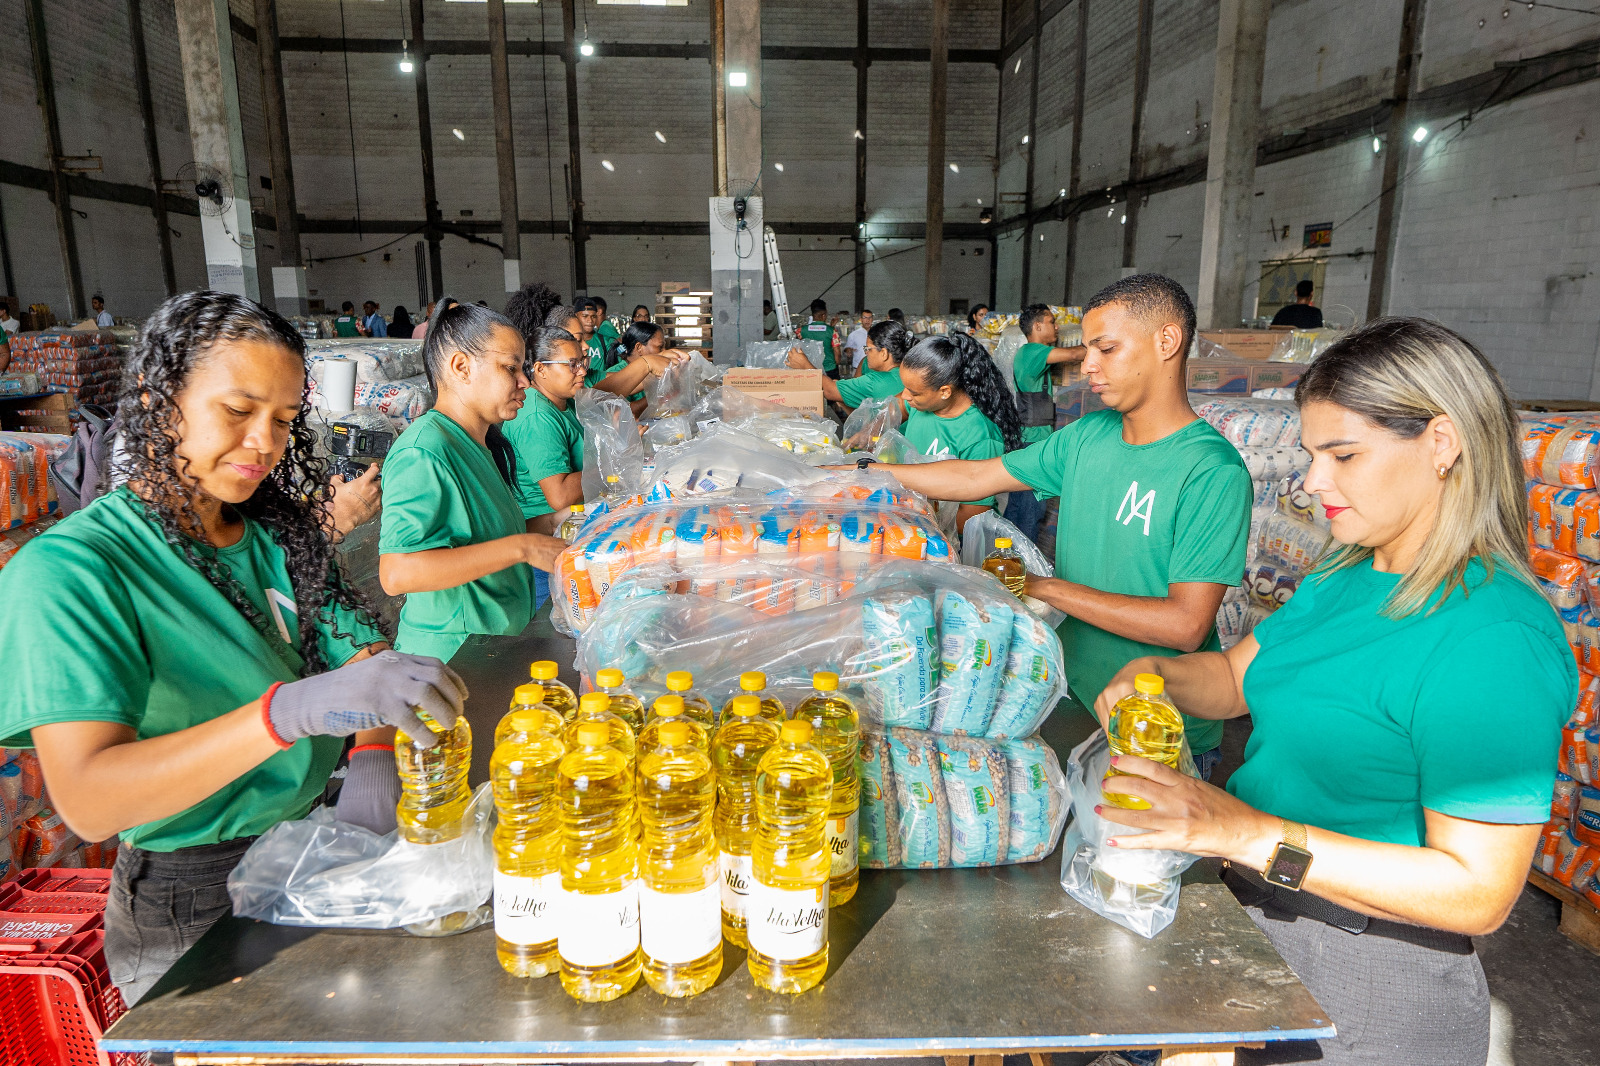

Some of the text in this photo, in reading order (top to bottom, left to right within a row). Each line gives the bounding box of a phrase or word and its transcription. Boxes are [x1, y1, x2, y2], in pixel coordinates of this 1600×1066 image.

[9, 470, 17, 504] BlueRice
[570, 579, 581, 621] BlueRice
[915, 635, 924, 646] Da
[916, 648, 926, 676] Fazenda
[918, 677, 926, 695] para
[972, 785, 989, 816] DULAR
[724, 869, 748, 890] Vila
[0, 921, 73, 932] CAMAÇARI
